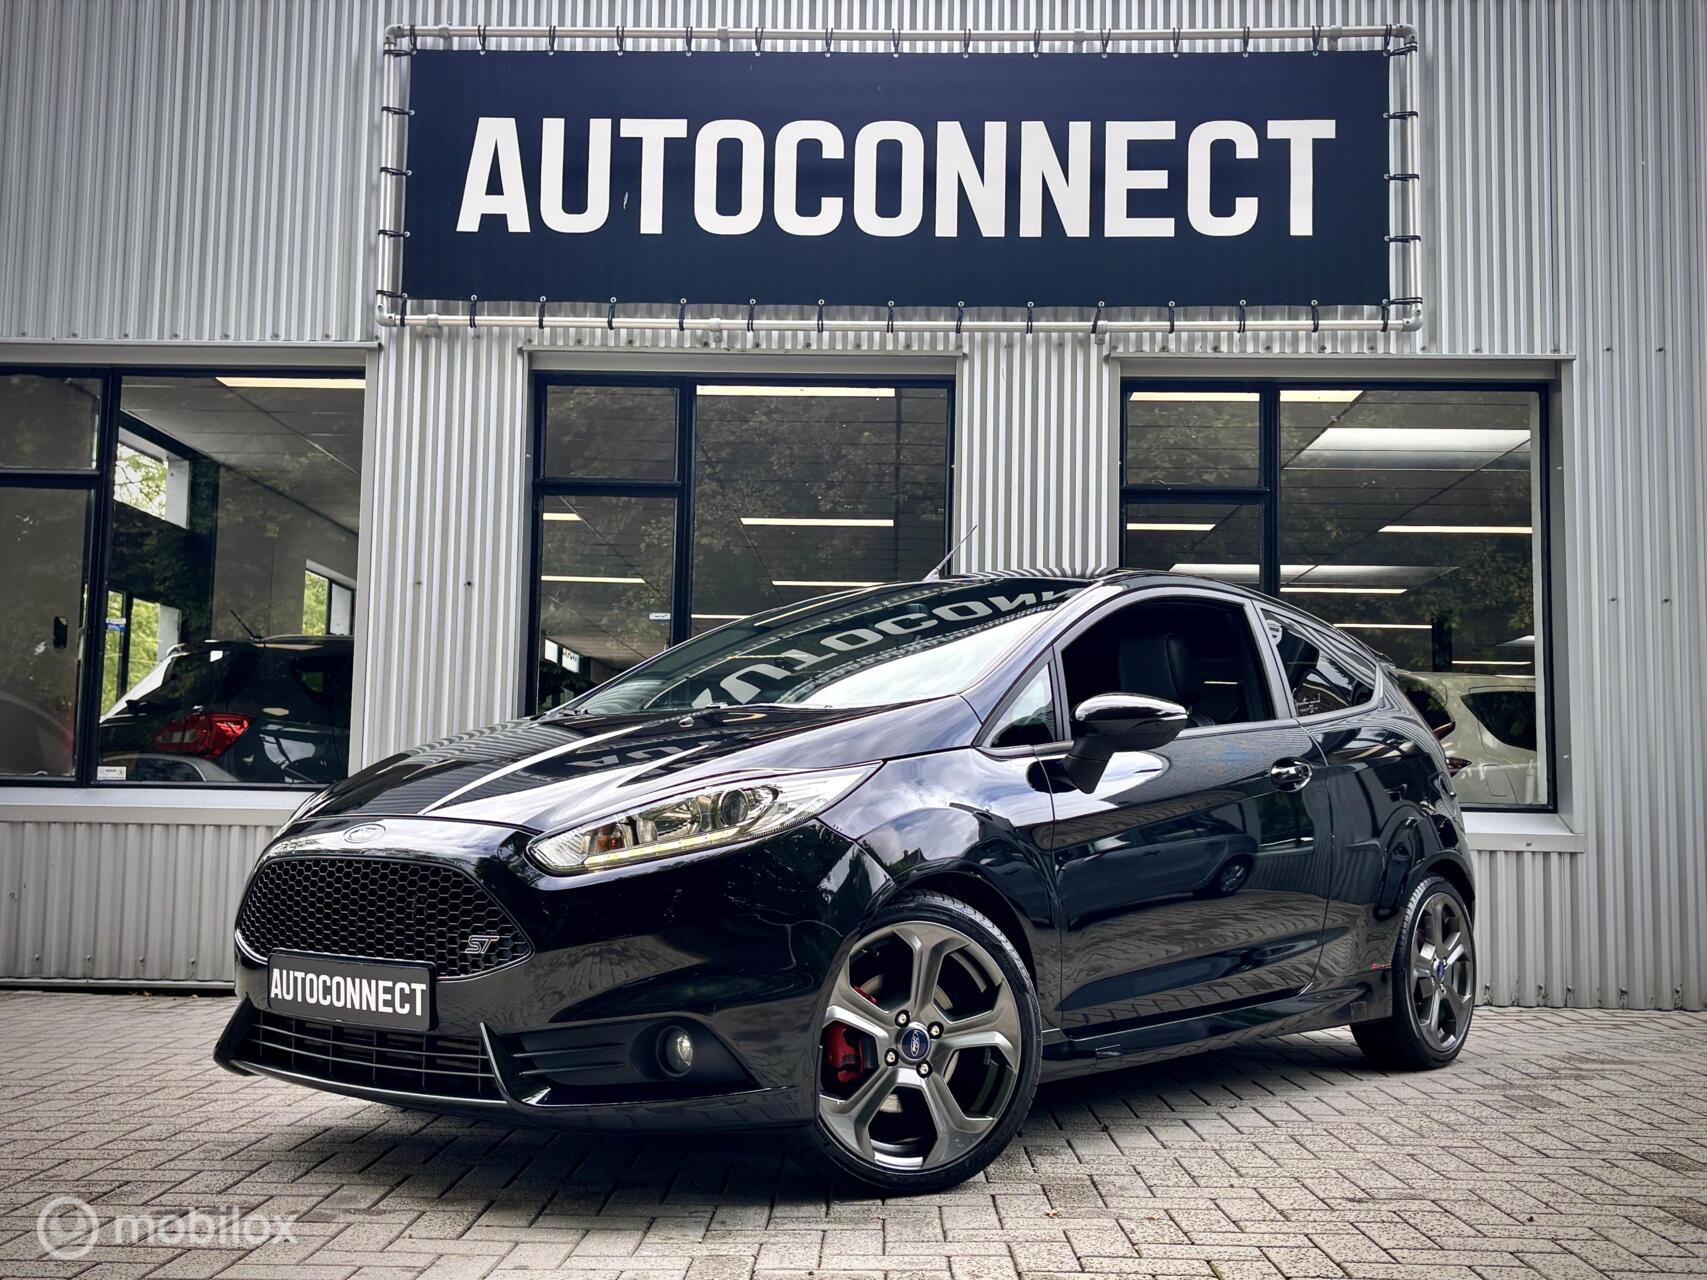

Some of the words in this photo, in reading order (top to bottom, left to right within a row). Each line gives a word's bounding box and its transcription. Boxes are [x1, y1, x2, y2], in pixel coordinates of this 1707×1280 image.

[456, 116, 1337, 238] AUTOCONNECT
[464, 934, 500, 954] ST
[270, 968, 427, 1016] AUTOCONNECT
